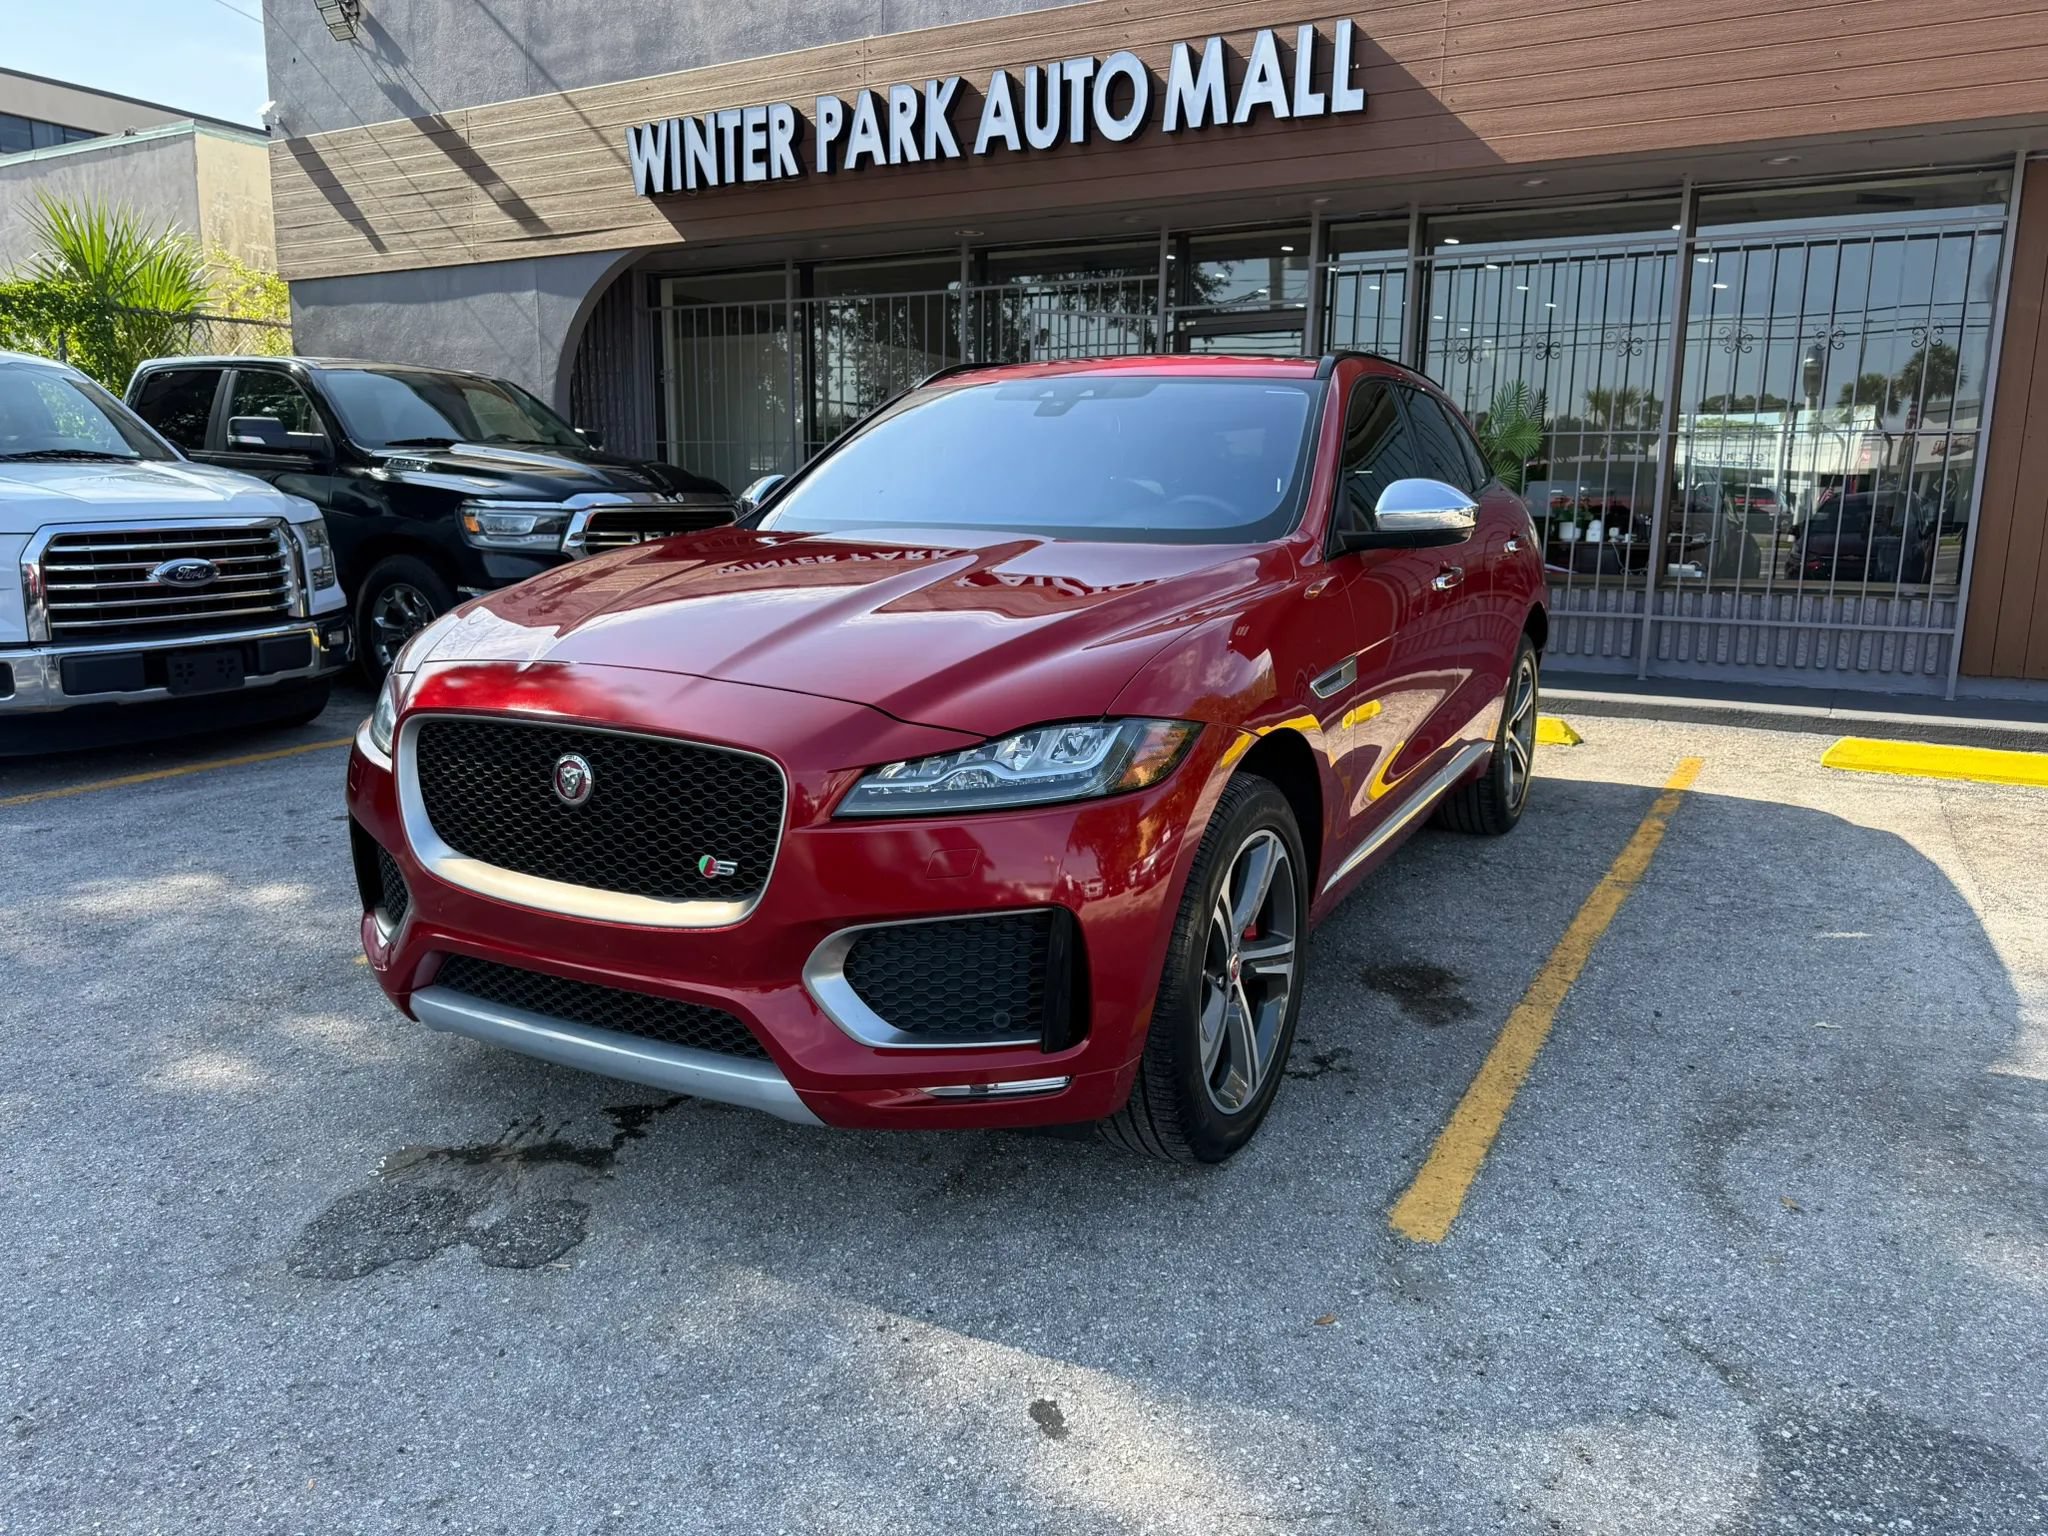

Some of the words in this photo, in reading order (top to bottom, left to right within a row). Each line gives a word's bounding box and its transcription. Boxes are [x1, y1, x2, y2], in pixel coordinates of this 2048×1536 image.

[624, 101, 801, 197] WINTER
[815, 76, 962, 174] PARK
[972, 50, 1153, 155] AUTO
[1161, 18, 1366, 132] MALL
[175, 565, 207, 580] Ford
